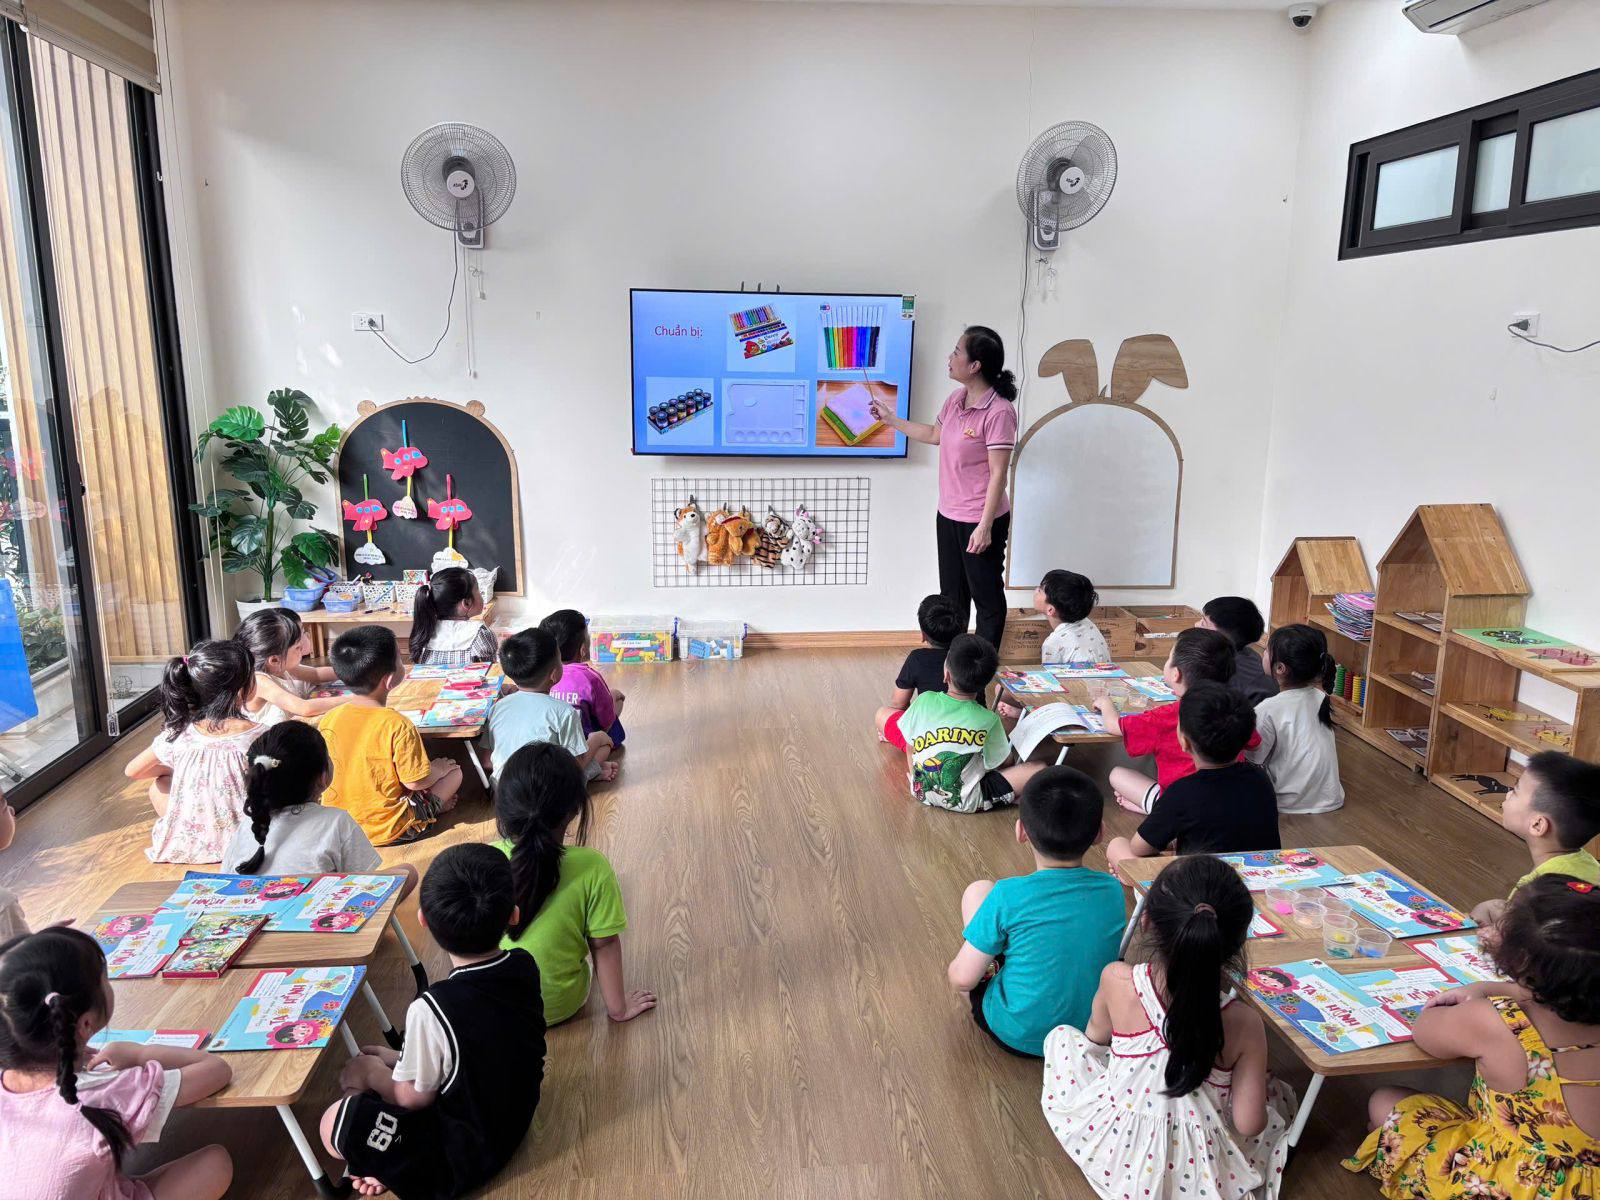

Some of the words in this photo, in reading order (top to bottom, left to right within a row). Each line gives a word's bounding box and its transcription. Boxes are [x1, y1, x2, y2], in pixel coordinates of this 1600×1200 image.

[654, 324, 688, 336] Chuẩn
[690, 325, 703, 339] bị:
[911, 727, 988, 753] OARING
[1325, 1003, 1361, 1026] HÌNH
[366, 1111, 398, 1152] 60
